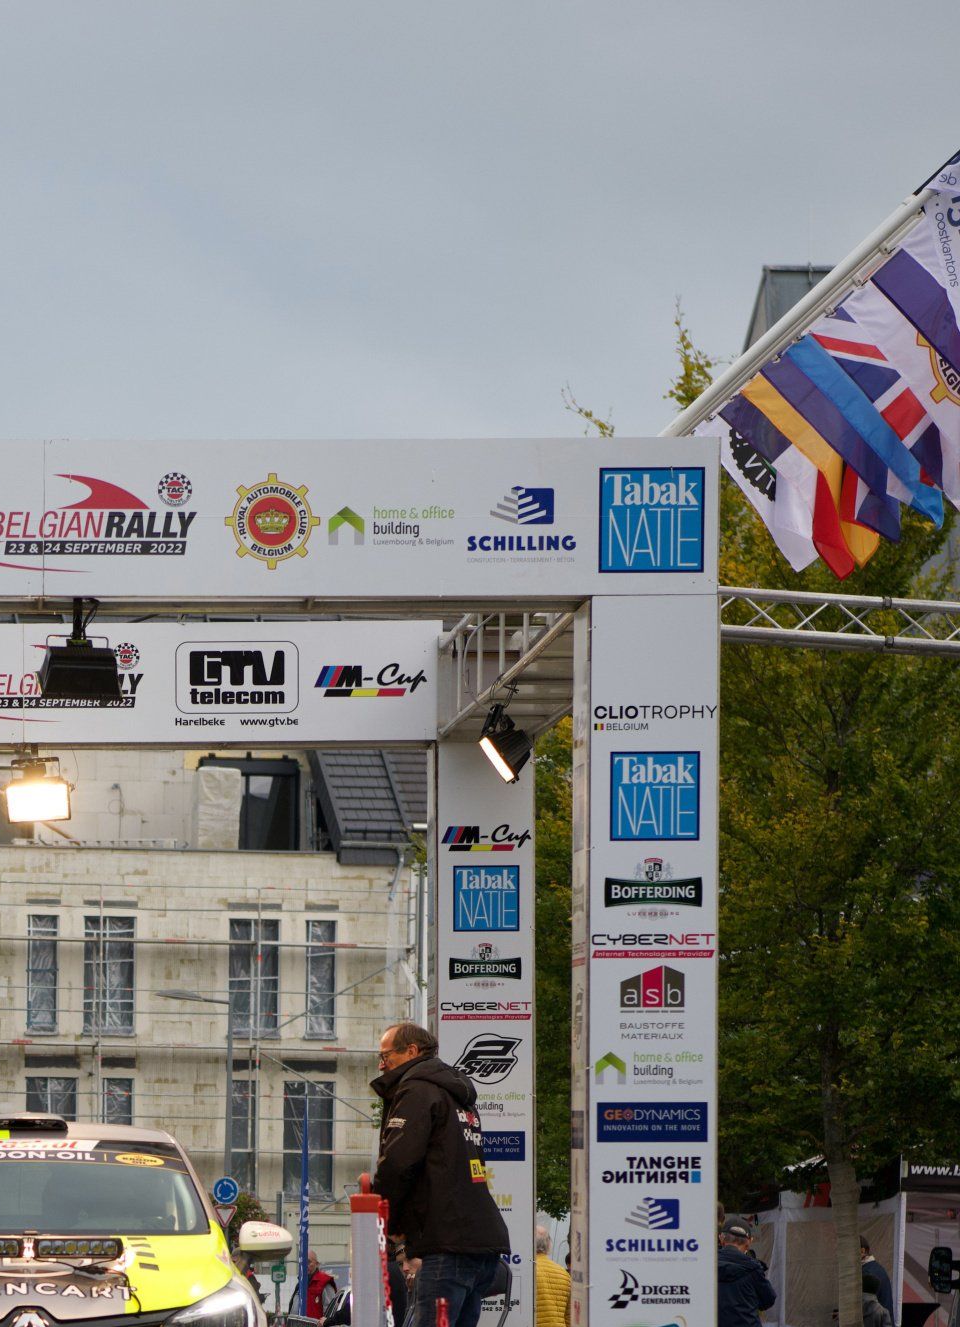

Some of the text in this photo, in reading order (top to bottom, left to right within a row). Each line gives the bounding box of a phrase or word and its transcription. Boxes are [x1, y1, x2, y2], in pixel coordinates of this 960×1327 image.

[605, 473, 698, 506] Tabak
[237, 486, 308, 535] ROYAL AUTOMOBILE CLUB
[373, 506, 455, 519] home office
[373, 522, 420, 537] building
[373, 538, 455, 547] Luxembourg Belgium
[467, 535, 577, 551] SCHILLING
[608, 508, 698, 567] NATIE
[9, 543, 183, 554] 23 24 SEPTEMBER 2022
[250, 543, 294, 557] BELGIUM
[23, 699, 35, 707] 24
[39, 699, 100, 707] SEPTEMBER
[190, 688, 285, 705] telecom
[594, 705, 718, 720] CLIOTROPHY
[175, 716, 299, 727] Harelbeke www.gtv.be
[606, 723, 649, 731] BELGIUM
[614, 756, 695, 784] Tabak
[618, 786, 695, 836] NATIE
[457, 869, 516, 890] Tabak
[611, 884, 695, 899] BOFFERDING
[459, 891, 516, 928] NATIE
[592, 934, 715, 945] CYBERNET
[627, 950, 677, 958] Technologies
[454, 963, 517, 974] BOFFERDING
[623, 983, 682, 1005] asb
[440, 1002, 532, 1011] CYBERNET
[620, 1022, 685, 1030] BAUSTOFFE
[621, 1032, 683, 1040] MATERIAUX
[633, 1052, 703, 1063] home office
[633, 1064, 673, 1078] building
[505, 1091, 526, 1100] office
[603, 1109, 701, 1121] GEODYNAMICS
[626, 1156, 701, 1169] TANGHE
[606, 1239, 699, 1252] SCHILLING
[641, 1285, 690, 1295] DIGER
